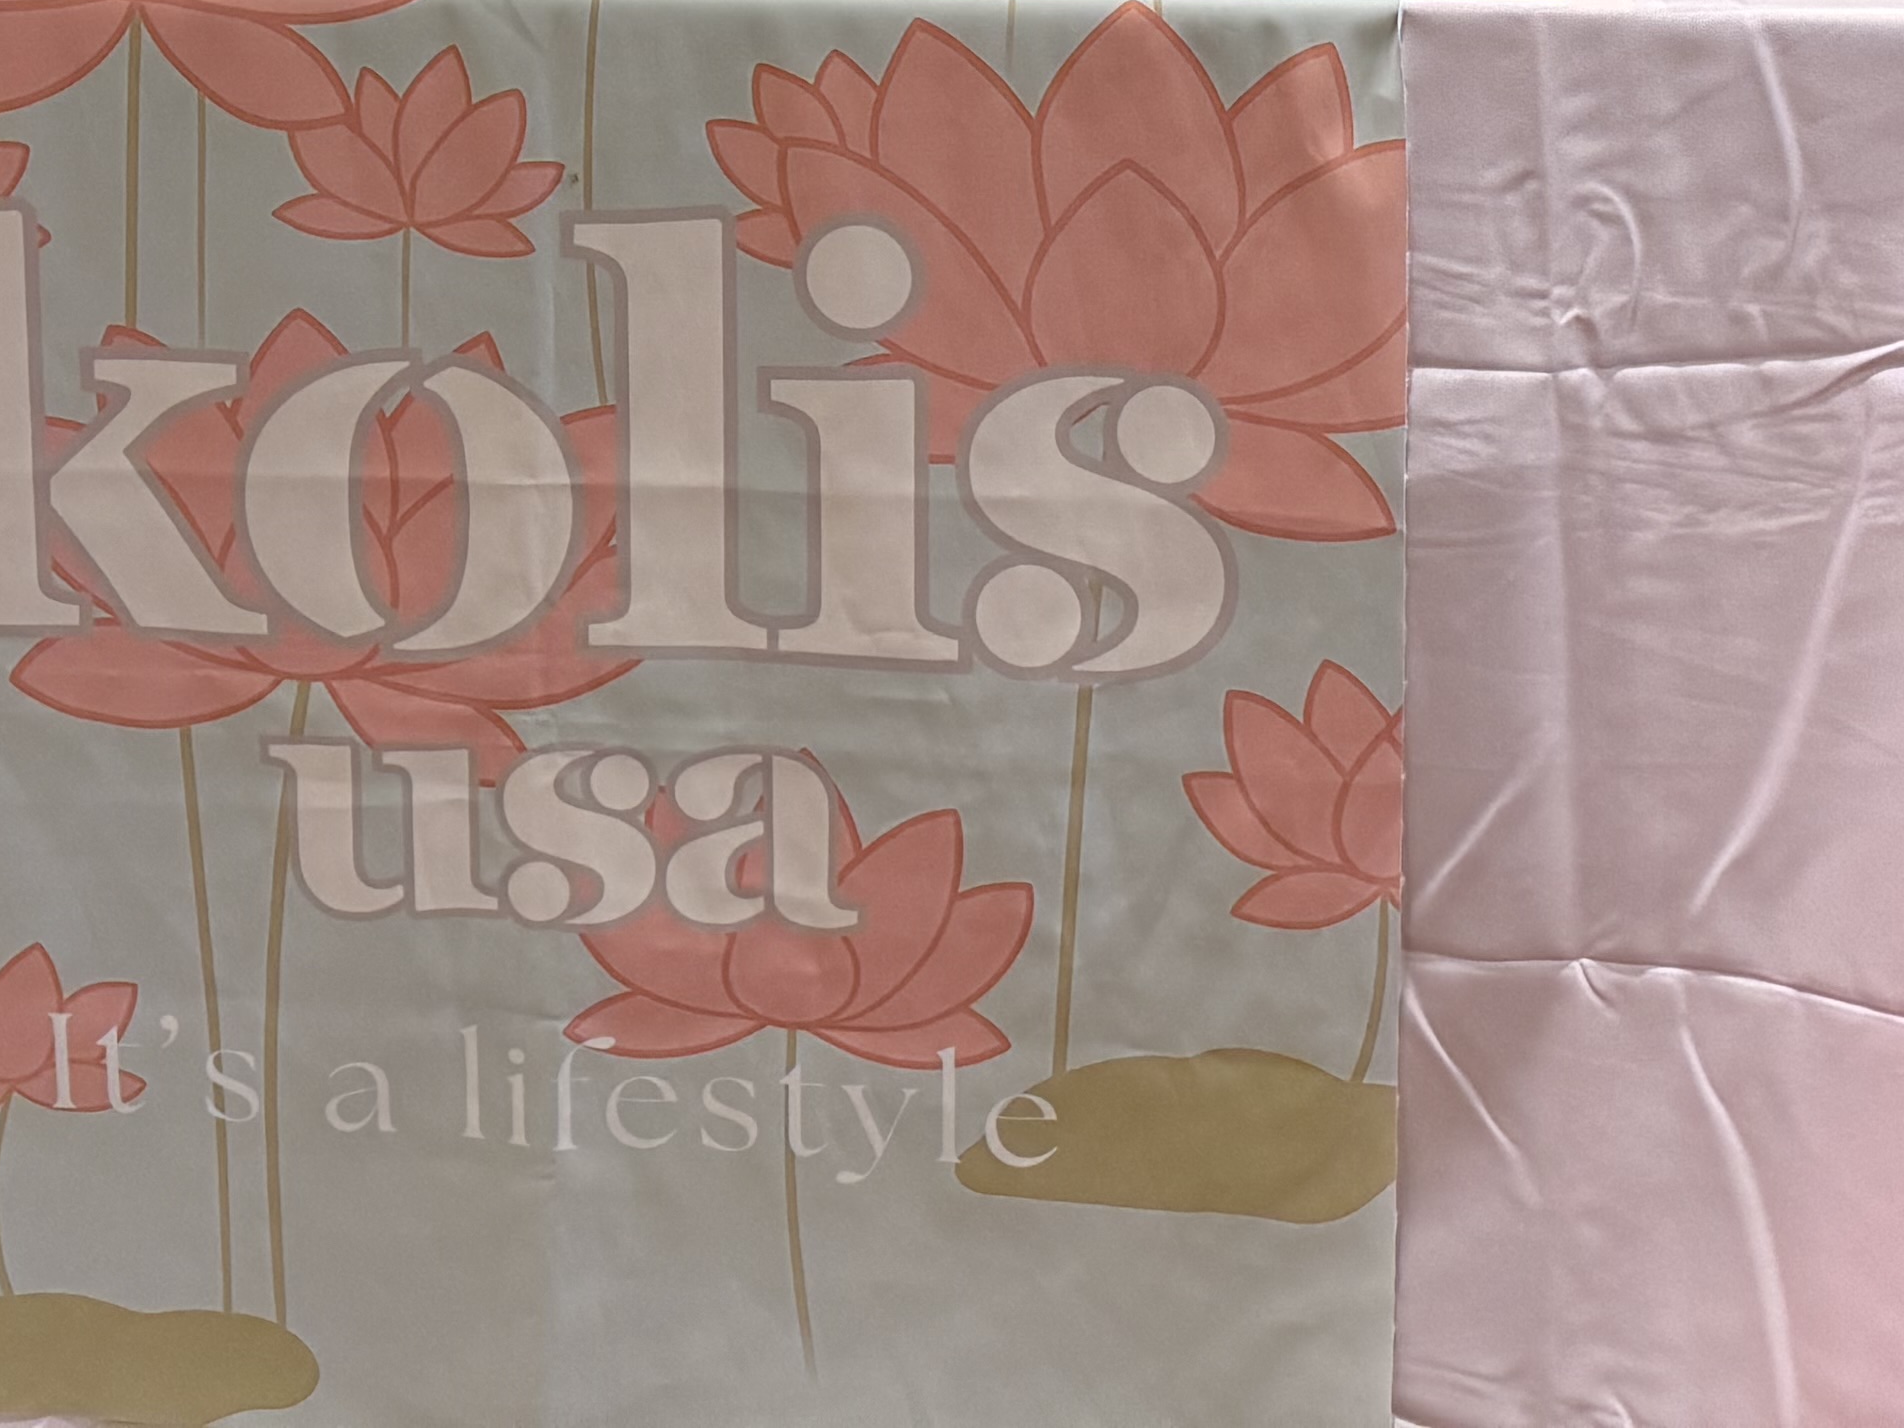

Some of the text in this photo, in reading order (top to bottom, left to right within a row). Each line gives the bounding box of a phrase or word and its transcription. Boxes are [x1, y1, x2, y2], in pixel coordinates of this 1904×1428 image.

[260, 738, 862, 933] usa
[324, 1052, 399, 1134] a
[459, 1024, 1060, 1186] lifestyle
